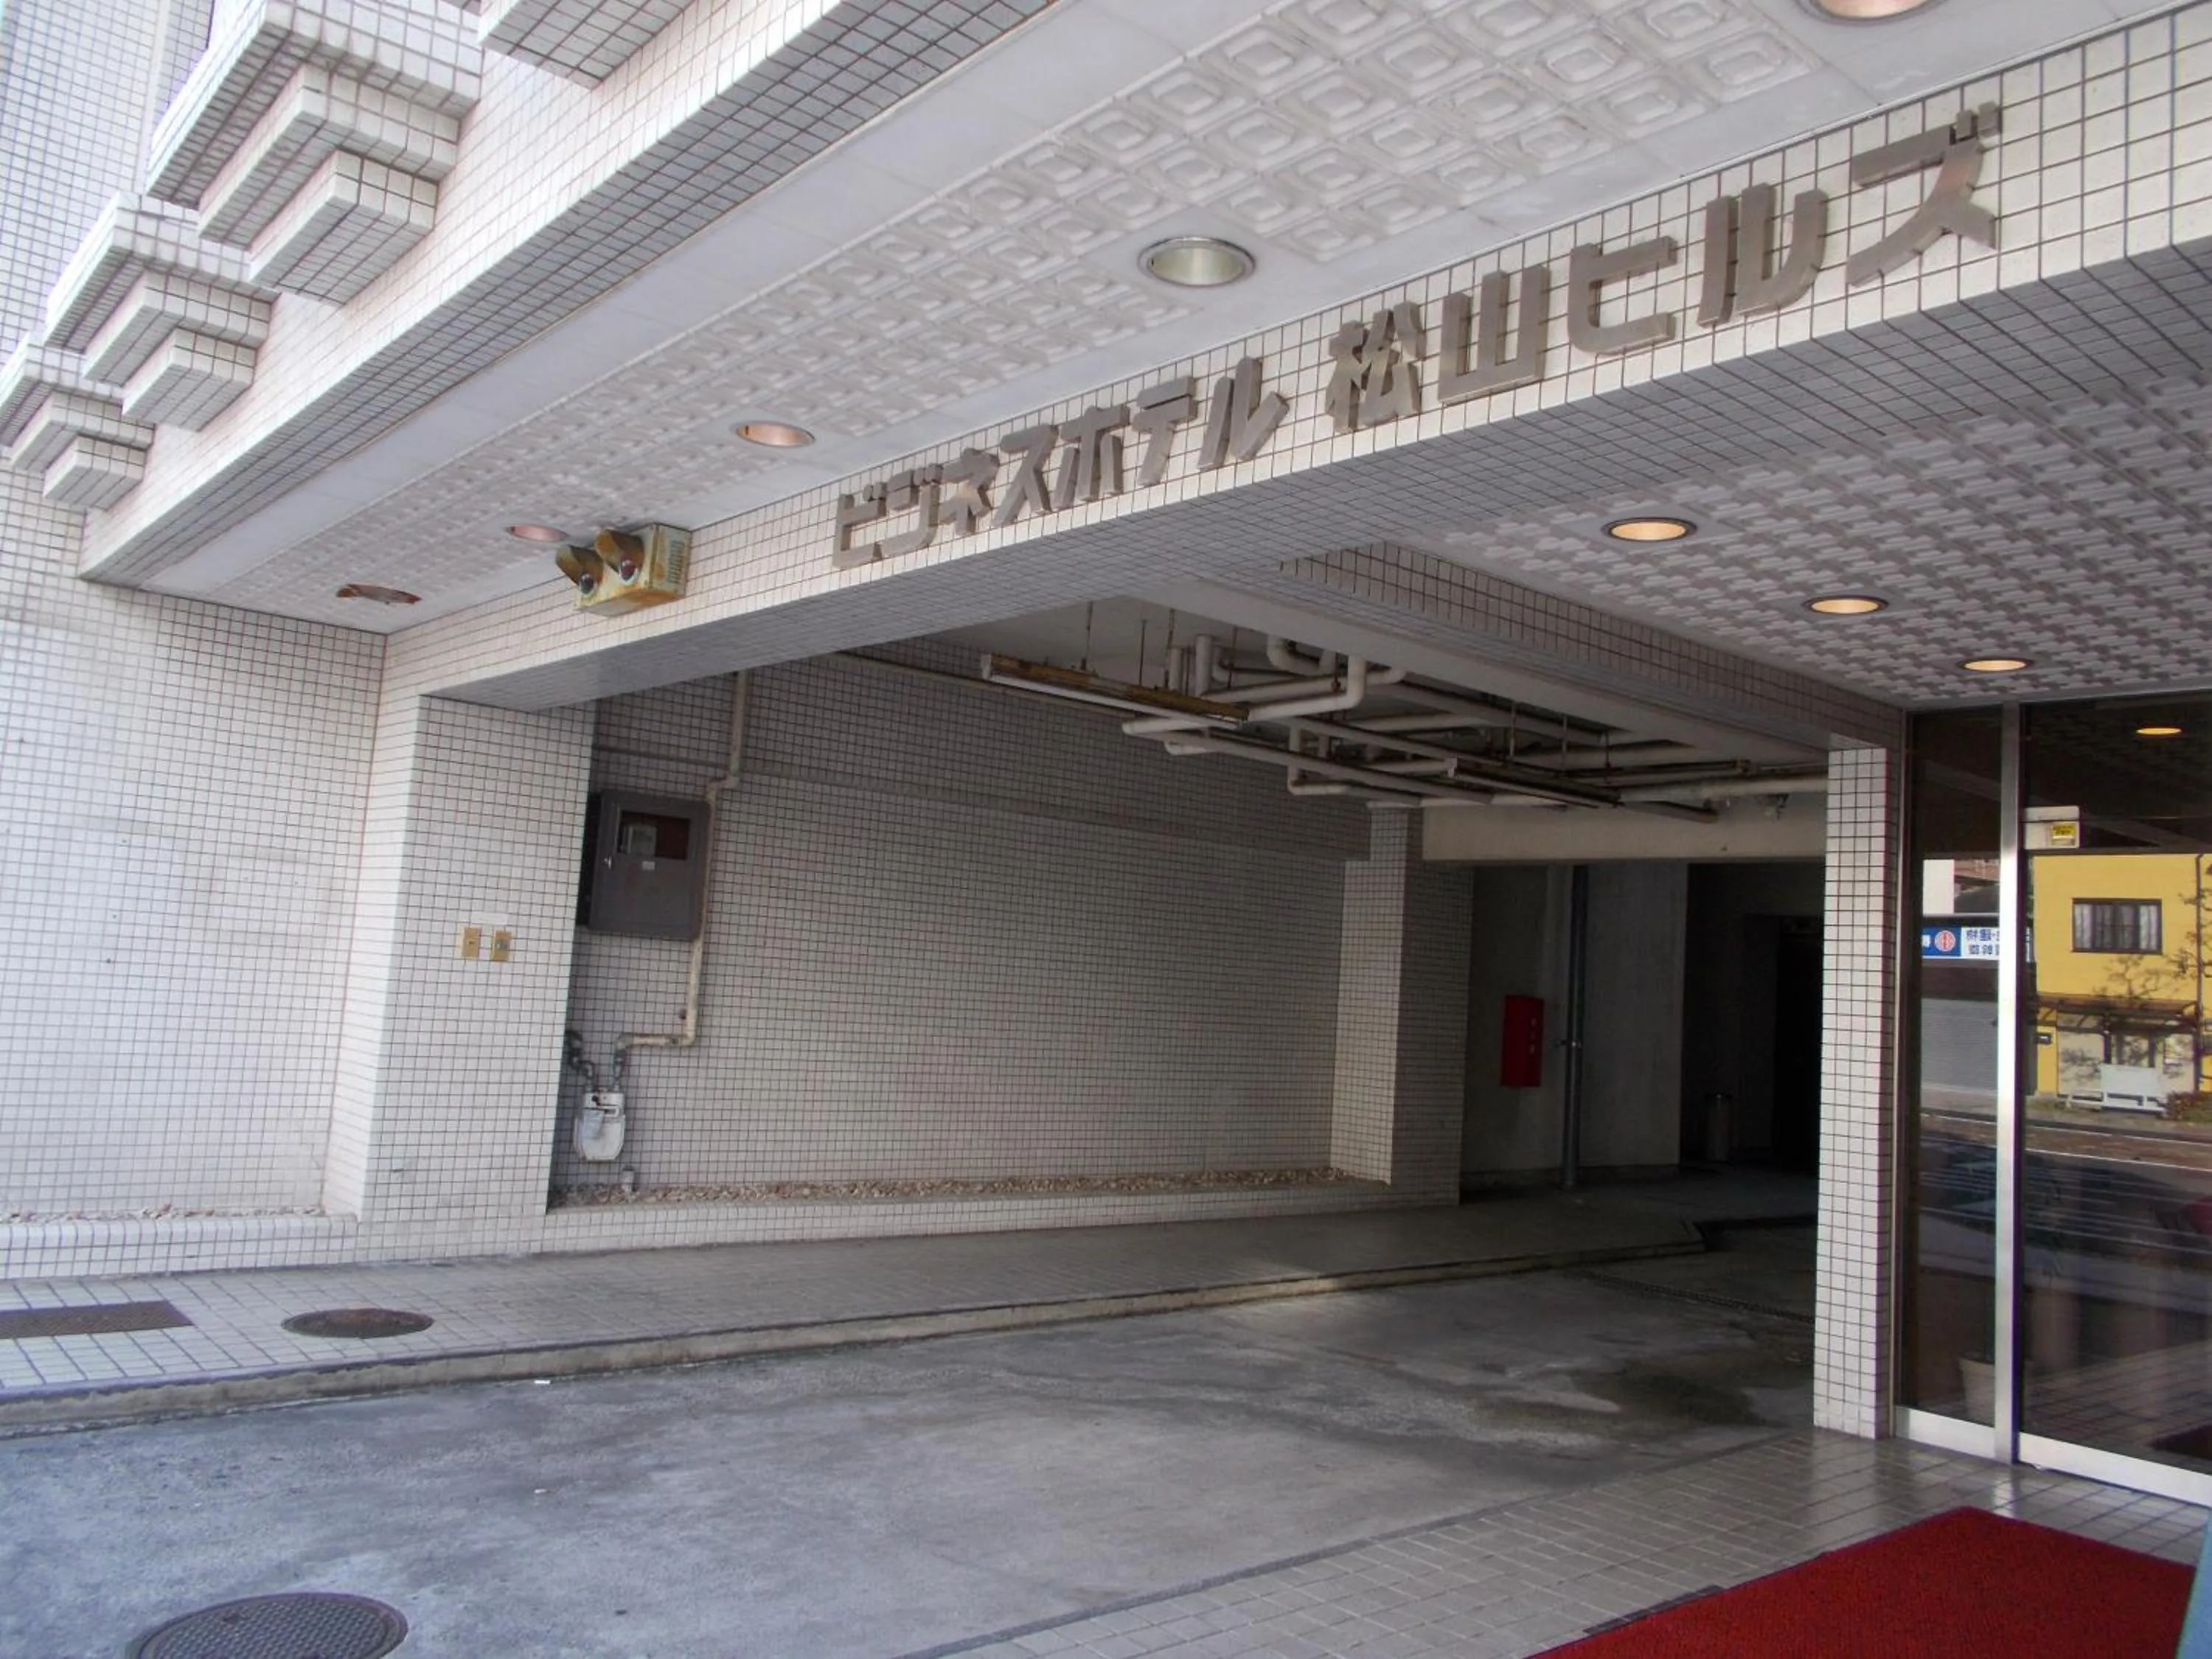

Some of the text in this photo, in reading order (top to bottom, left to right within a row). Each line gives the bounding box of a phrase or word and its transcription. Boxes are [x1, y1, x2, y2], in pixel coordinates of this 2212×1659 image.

[832, 101, 2000, 568] ビジネスホテル 松山ヒルズ
